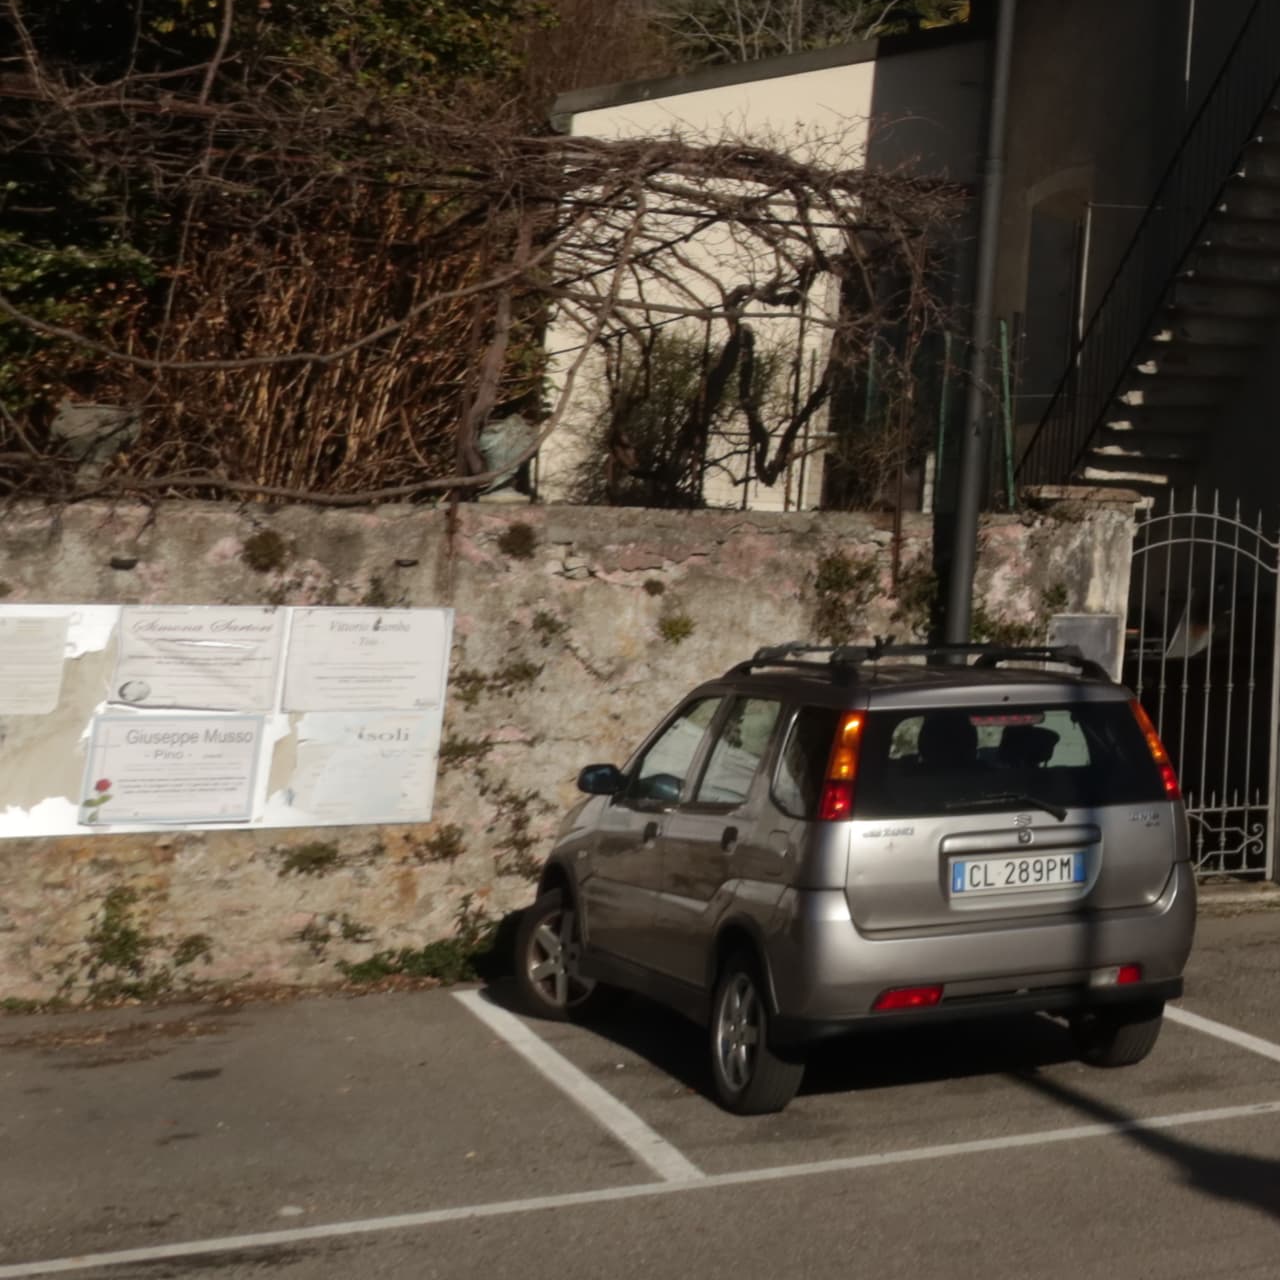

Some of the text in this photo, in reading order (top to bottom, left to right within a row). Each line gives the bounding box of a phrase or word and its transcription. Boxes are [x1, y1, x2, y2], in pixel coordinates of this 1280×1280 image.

[126, 728, 253, 747] Giuseppe Musso
[968, 863, 996, 888] CL
[1003, 854, 1073, 886] 289PM
